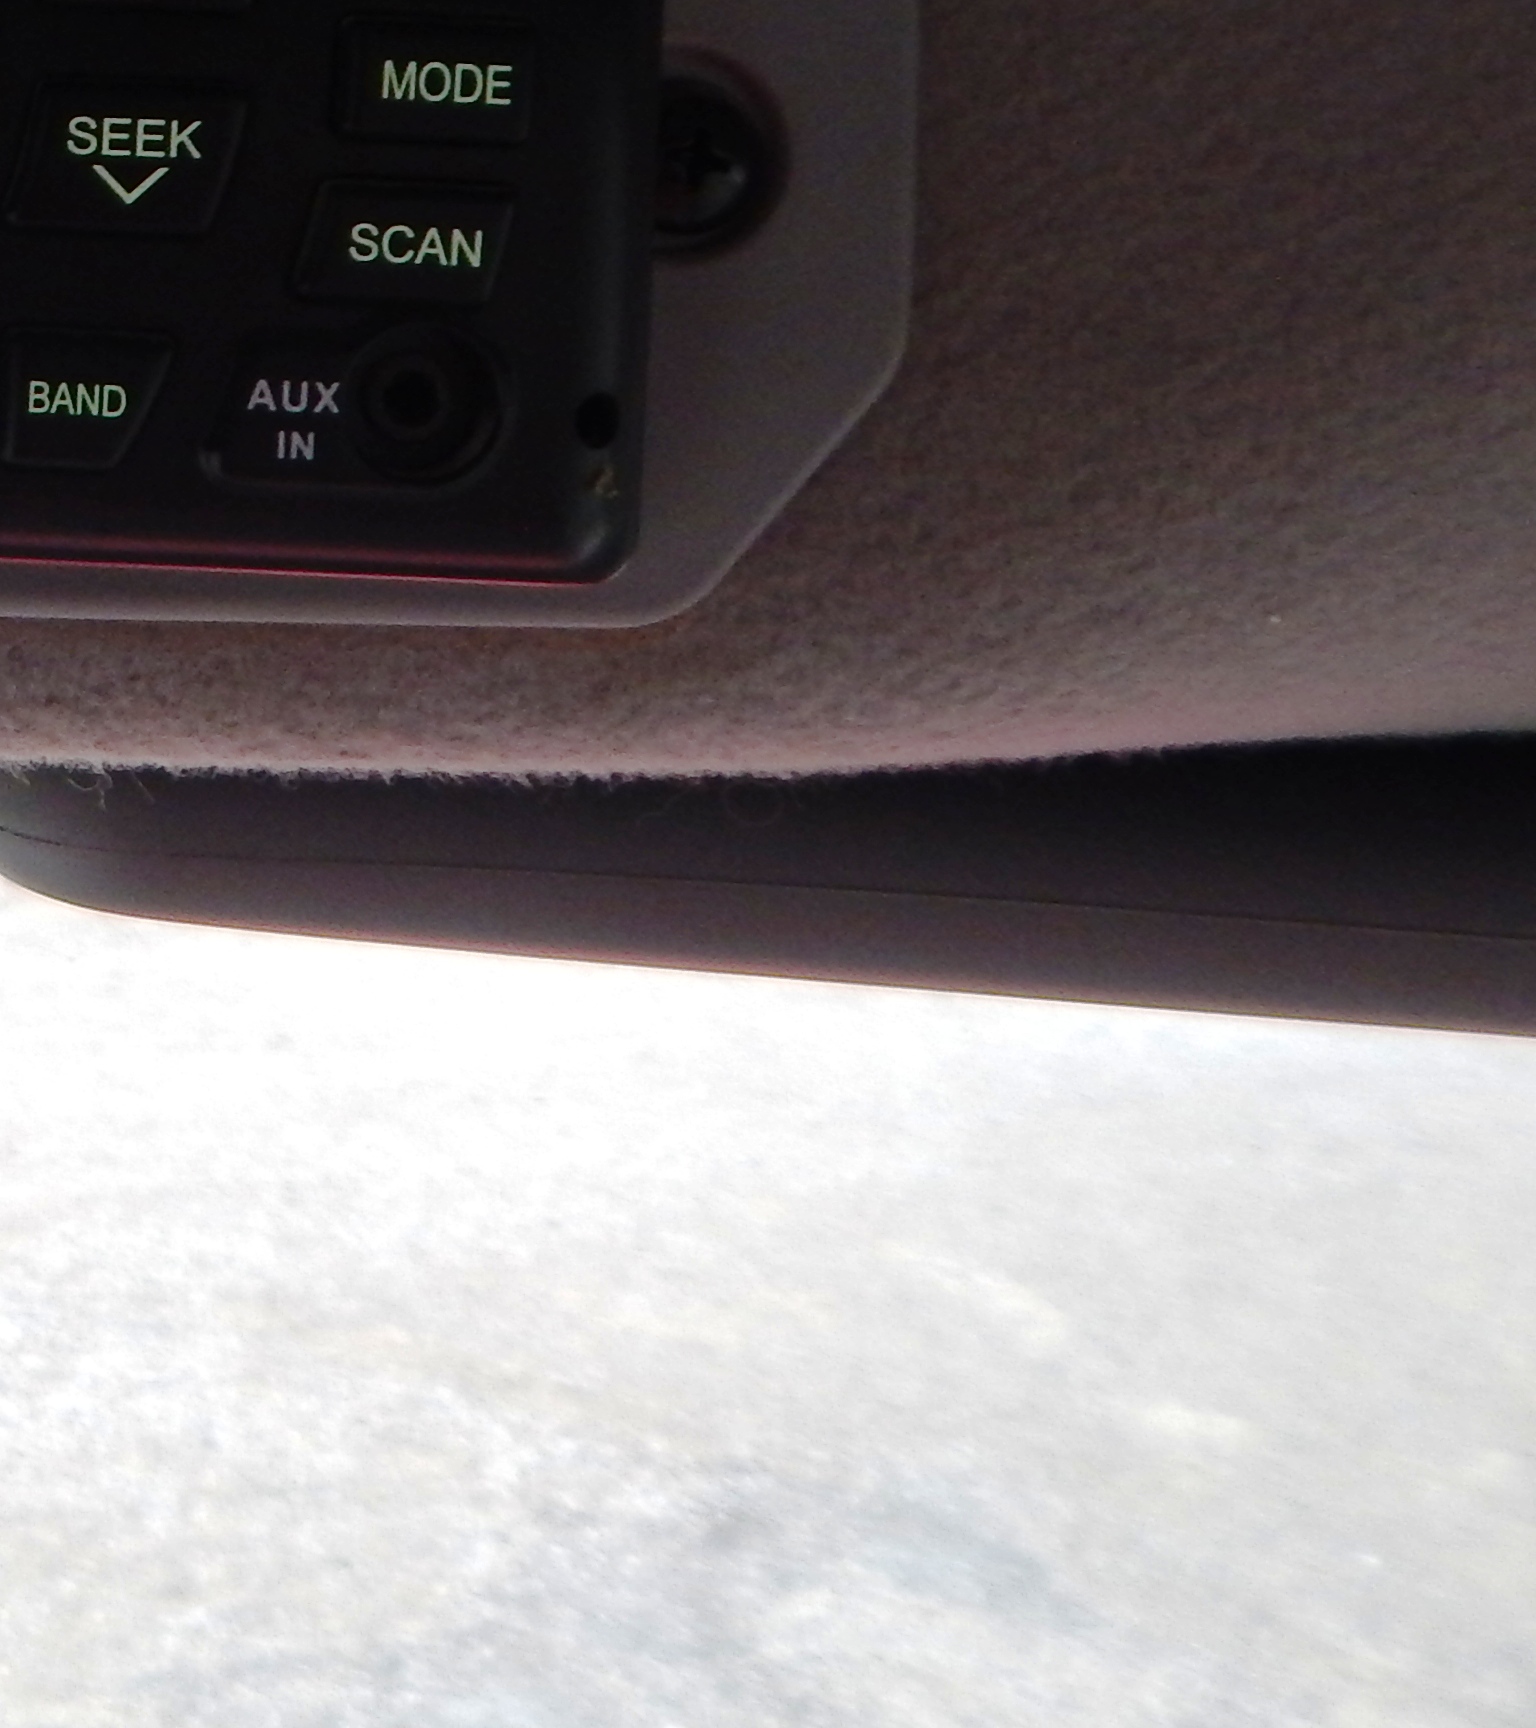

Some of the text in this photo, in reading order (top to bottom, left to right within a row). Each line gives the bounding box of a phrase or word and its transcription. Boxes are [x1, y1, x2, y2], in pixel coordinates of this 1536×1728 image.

[381, 59, 513, 106] MODE
[66, 115, 202, 159] SEEK
[348, 222, 483, 268] SCAN
[27, 380, 127, 418] BAND
[246, 378, 340, 414] AUX
[276, 430, 315, 461] IN
